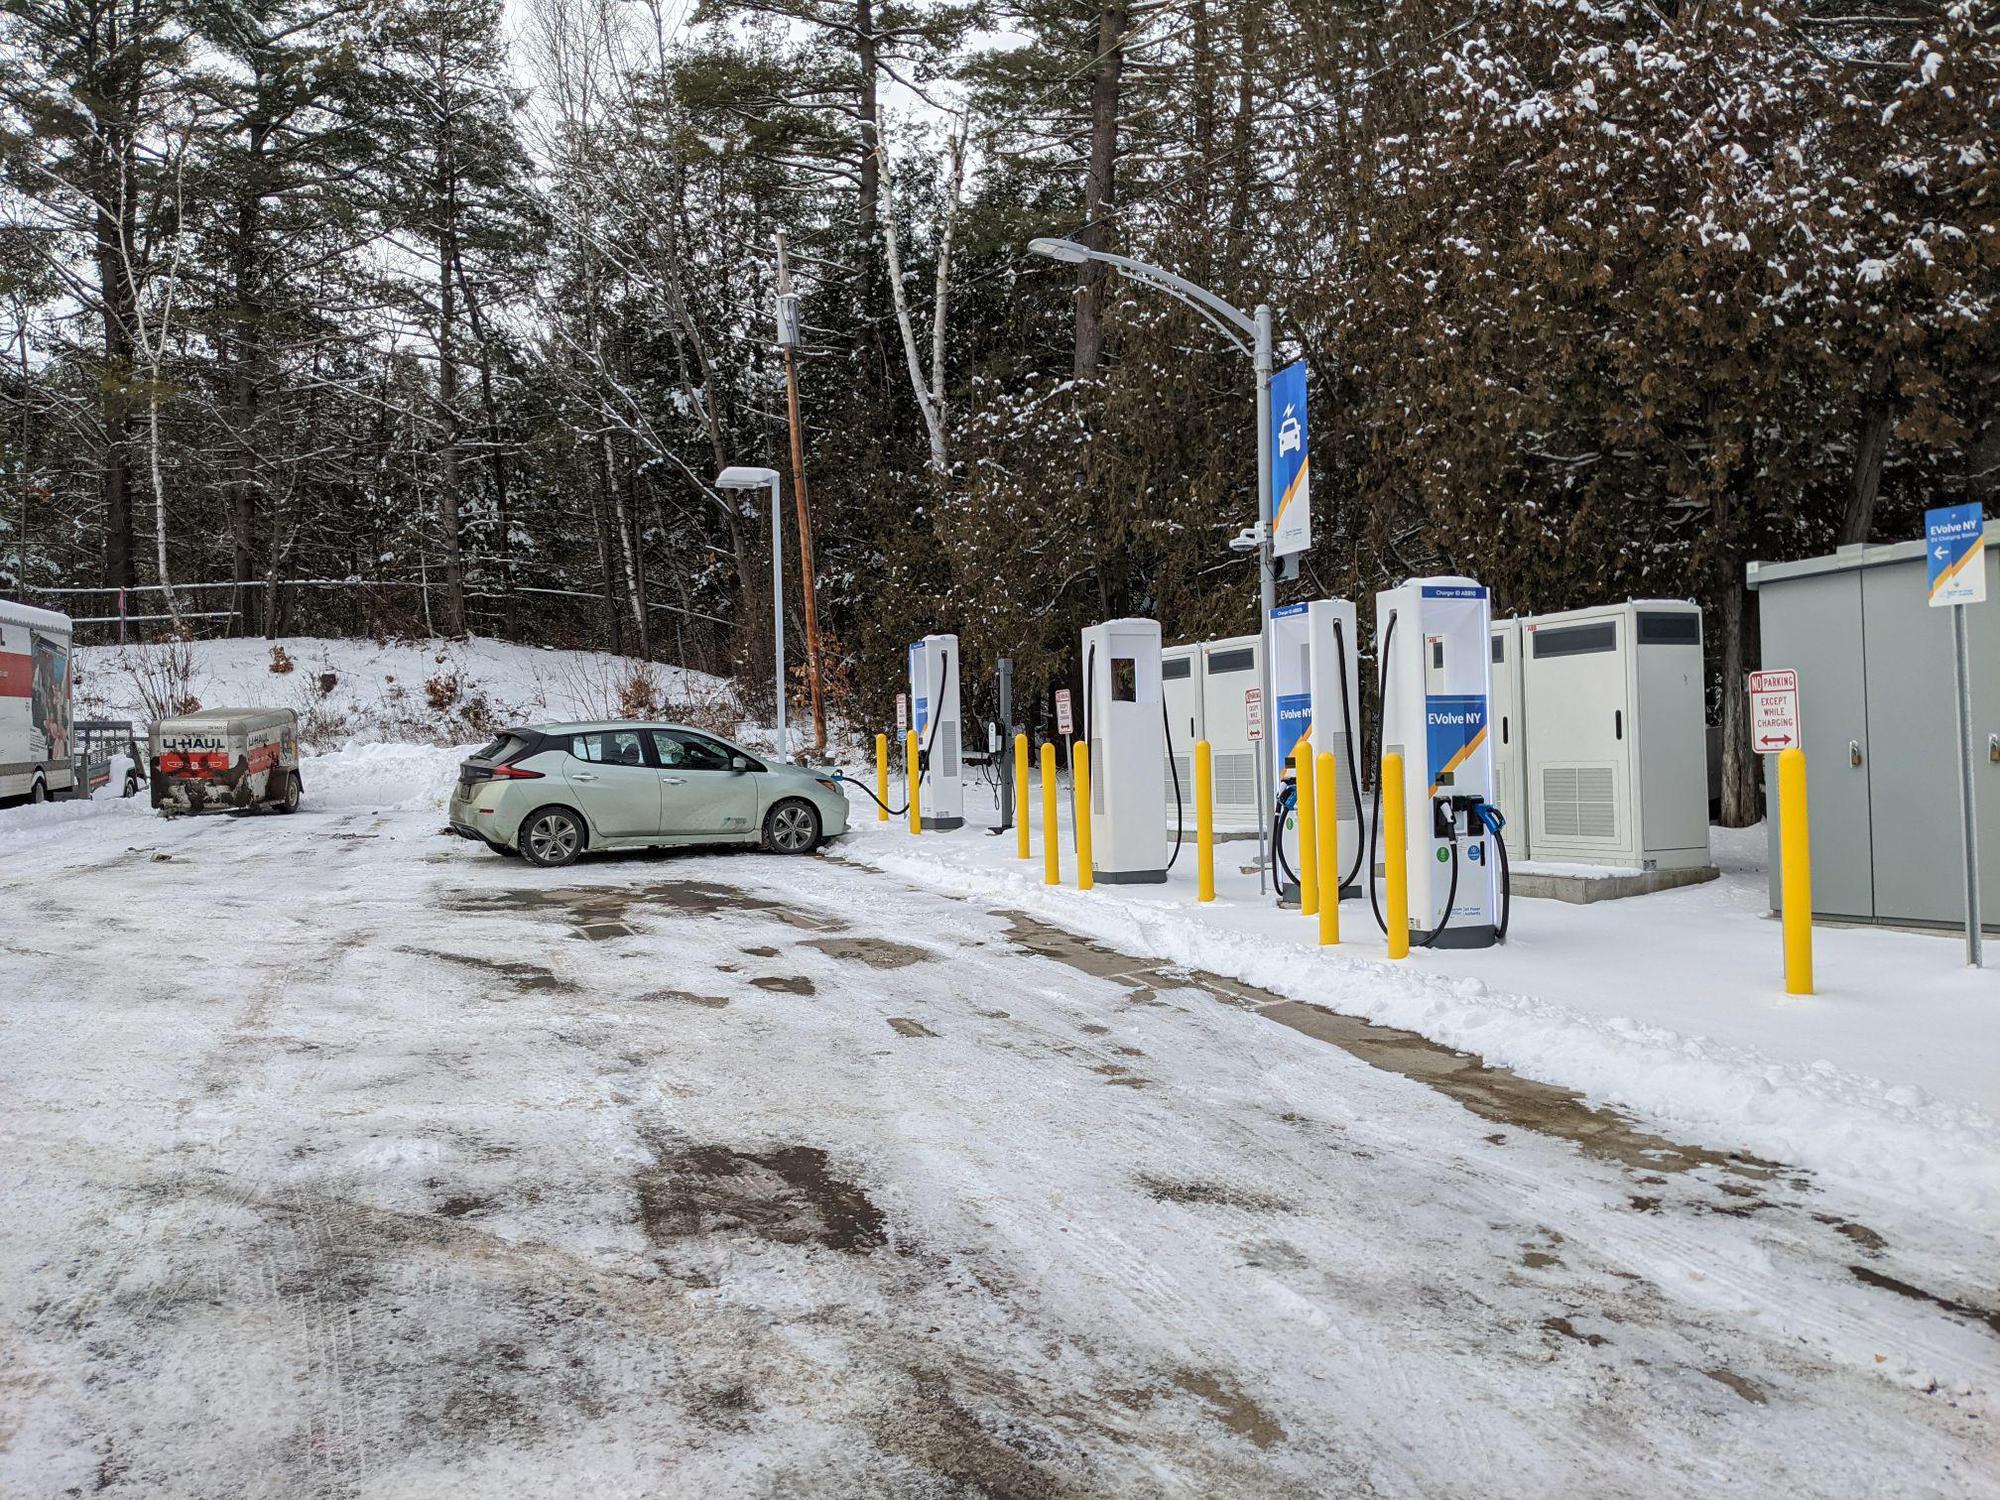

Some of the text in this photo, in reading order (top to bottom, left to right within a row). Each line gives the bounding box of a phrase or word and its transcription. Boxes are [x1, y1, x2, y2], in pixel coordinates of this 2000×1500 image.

[1930, 520, 1977, 536] EVolve NY
[1751, 676, 1793, 691] NO PARKING
[1761, 696, 1787, 706] EXCEPT
[1280, 709, 1301, 720] EVolve
[1763, 707, 1785, 716] WHILE
[1428, 712, 1481, 725] EVolve NY
[1757, 719, 1793, 728] CHARGING
[163, 738, 226, 749] U-HAUL
